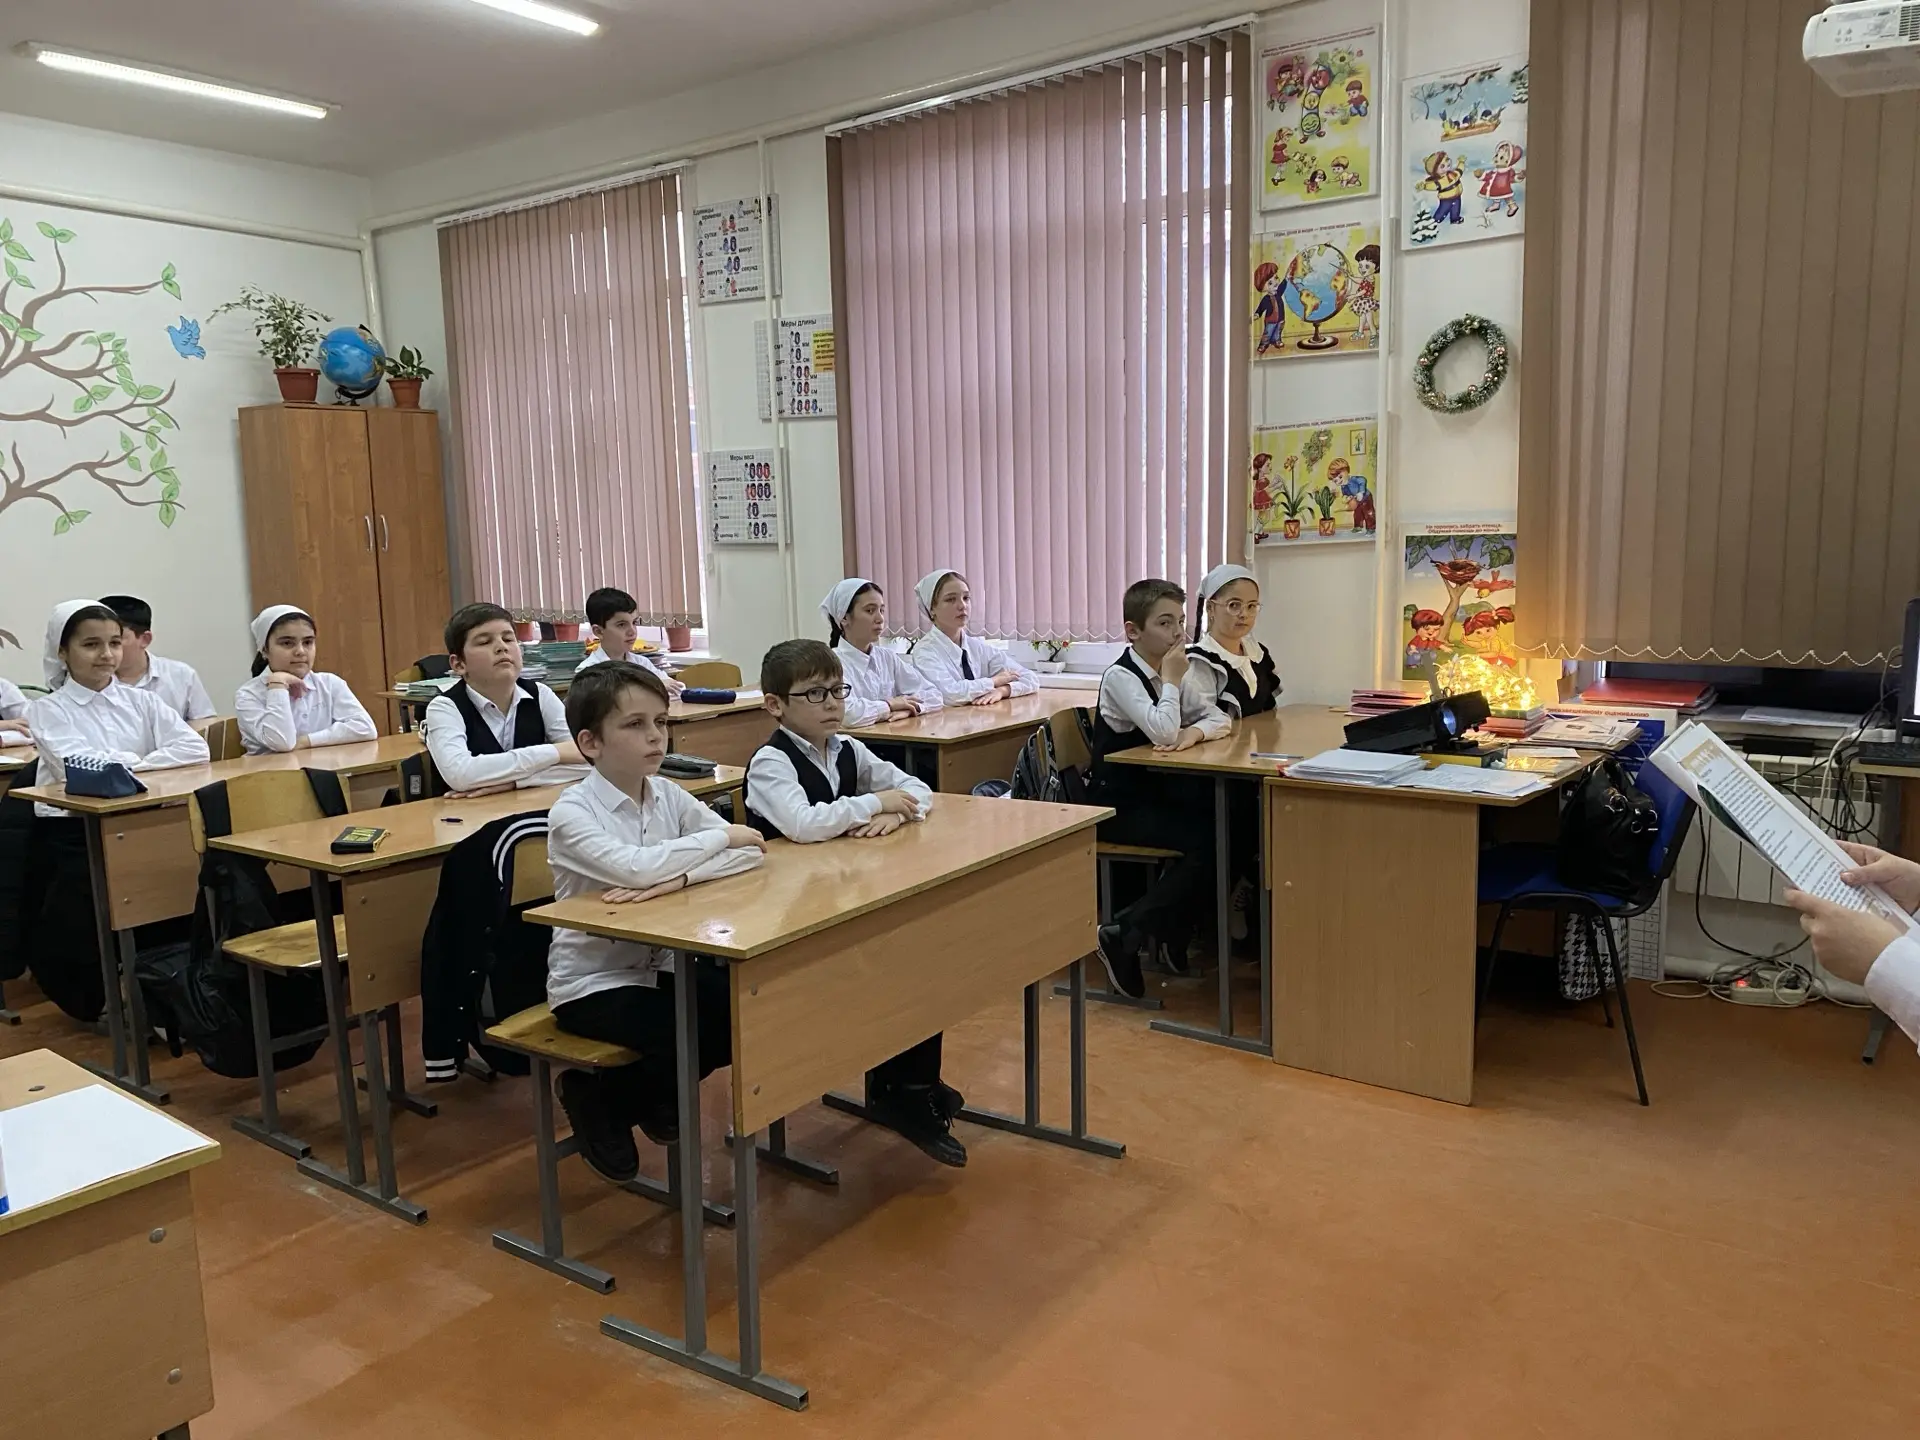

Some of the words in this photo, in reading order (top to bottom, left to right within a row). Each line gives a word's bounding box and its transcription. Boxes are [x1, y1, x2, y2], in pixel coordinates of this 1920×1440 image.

[780, 319, 797, 328] Меры
[798, 318, 817, 326] длины
[1604, 710, 1650, 718] ОЦЕНИВАНИЮ
